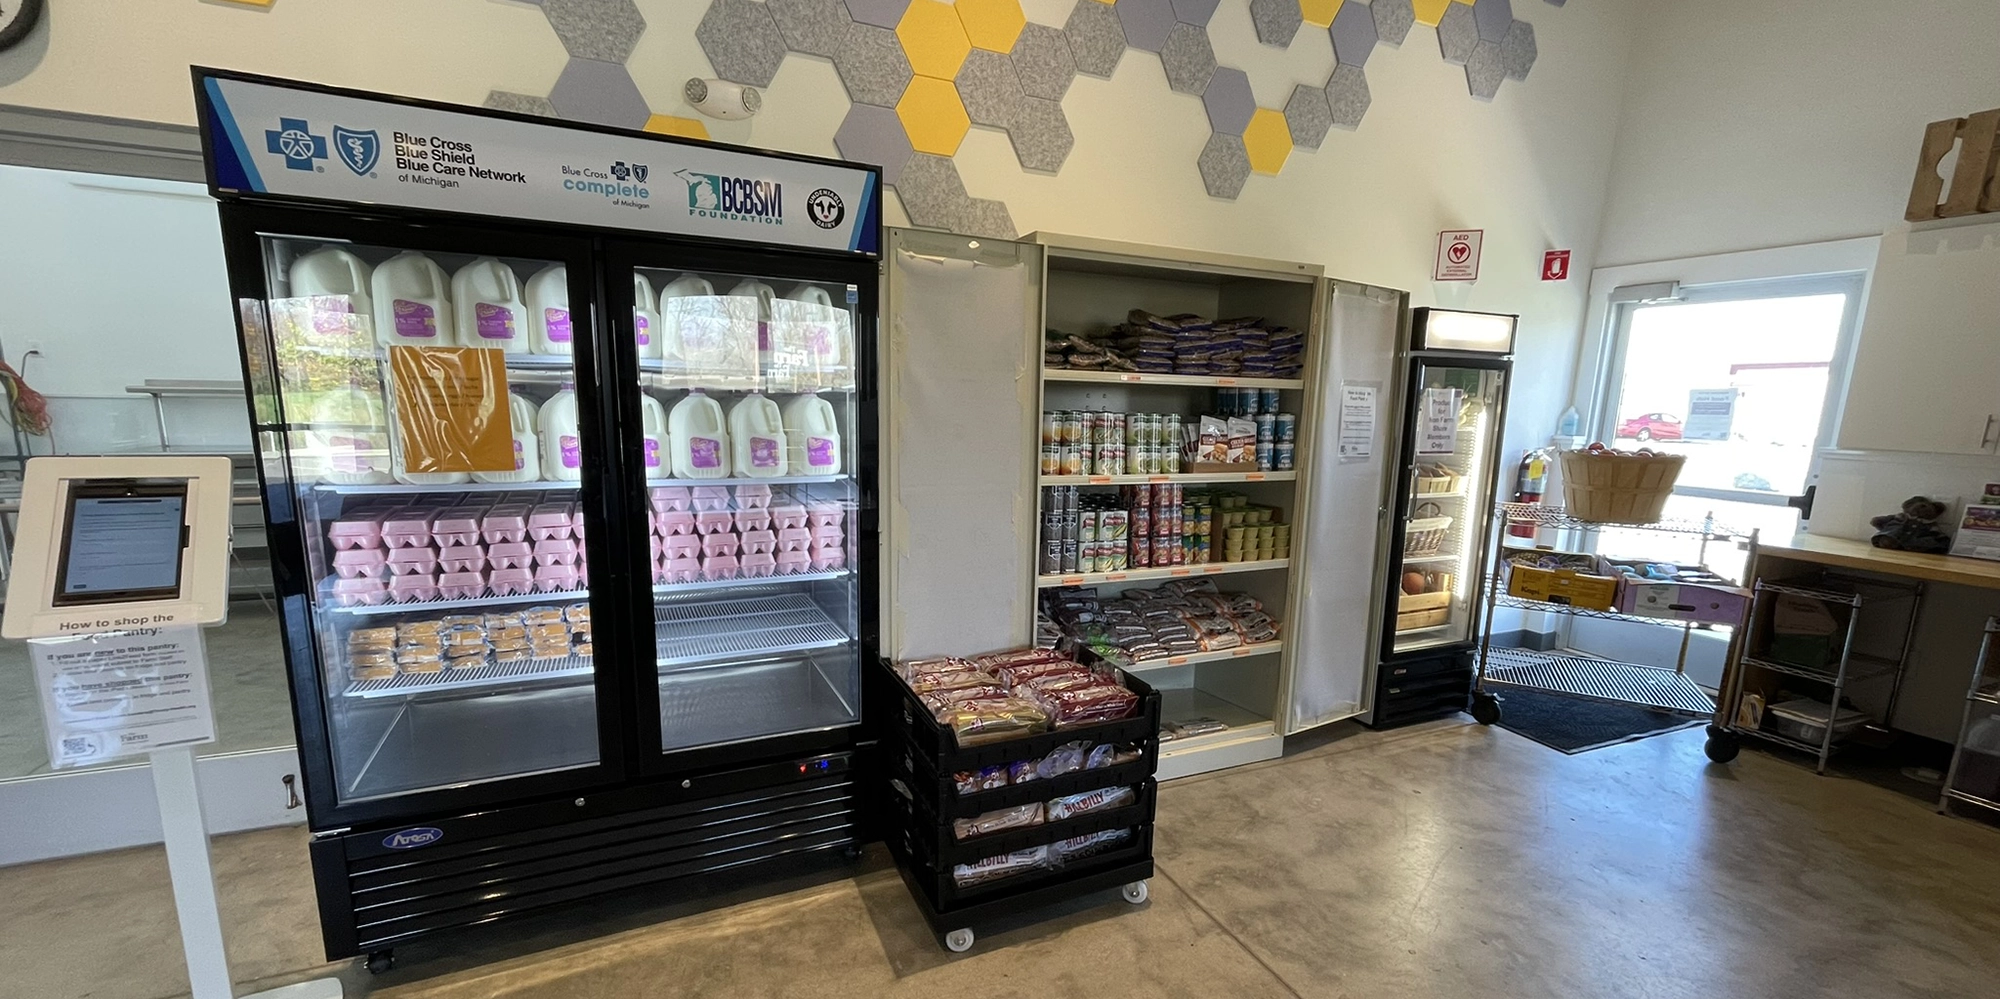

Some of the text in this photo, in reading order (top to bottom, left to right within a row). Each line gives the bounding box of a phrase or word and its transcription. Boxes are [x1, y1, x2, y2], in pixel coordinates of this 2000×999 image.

[393, 131, 473, 153] Blue Cross
[394, 144, 476, 166] Blue Shield
[396, 157, 527, 184] Blue Care Network
[561, 165, 608, 180] Blue Cross
[398, 173, 460, 189] of Michigan
[563, 178, 650, 199] complete
[612, 198, 650, 210] of Michigan
[721, 176, 783, 218] BCBSM
[689, 208, 784, 226] FOUNDATION
[59, 614, 174, 631] How to shop the
[147, 642, 180, 652] pantry:
[1064, 791, 1105, 813] HILLBILLY
